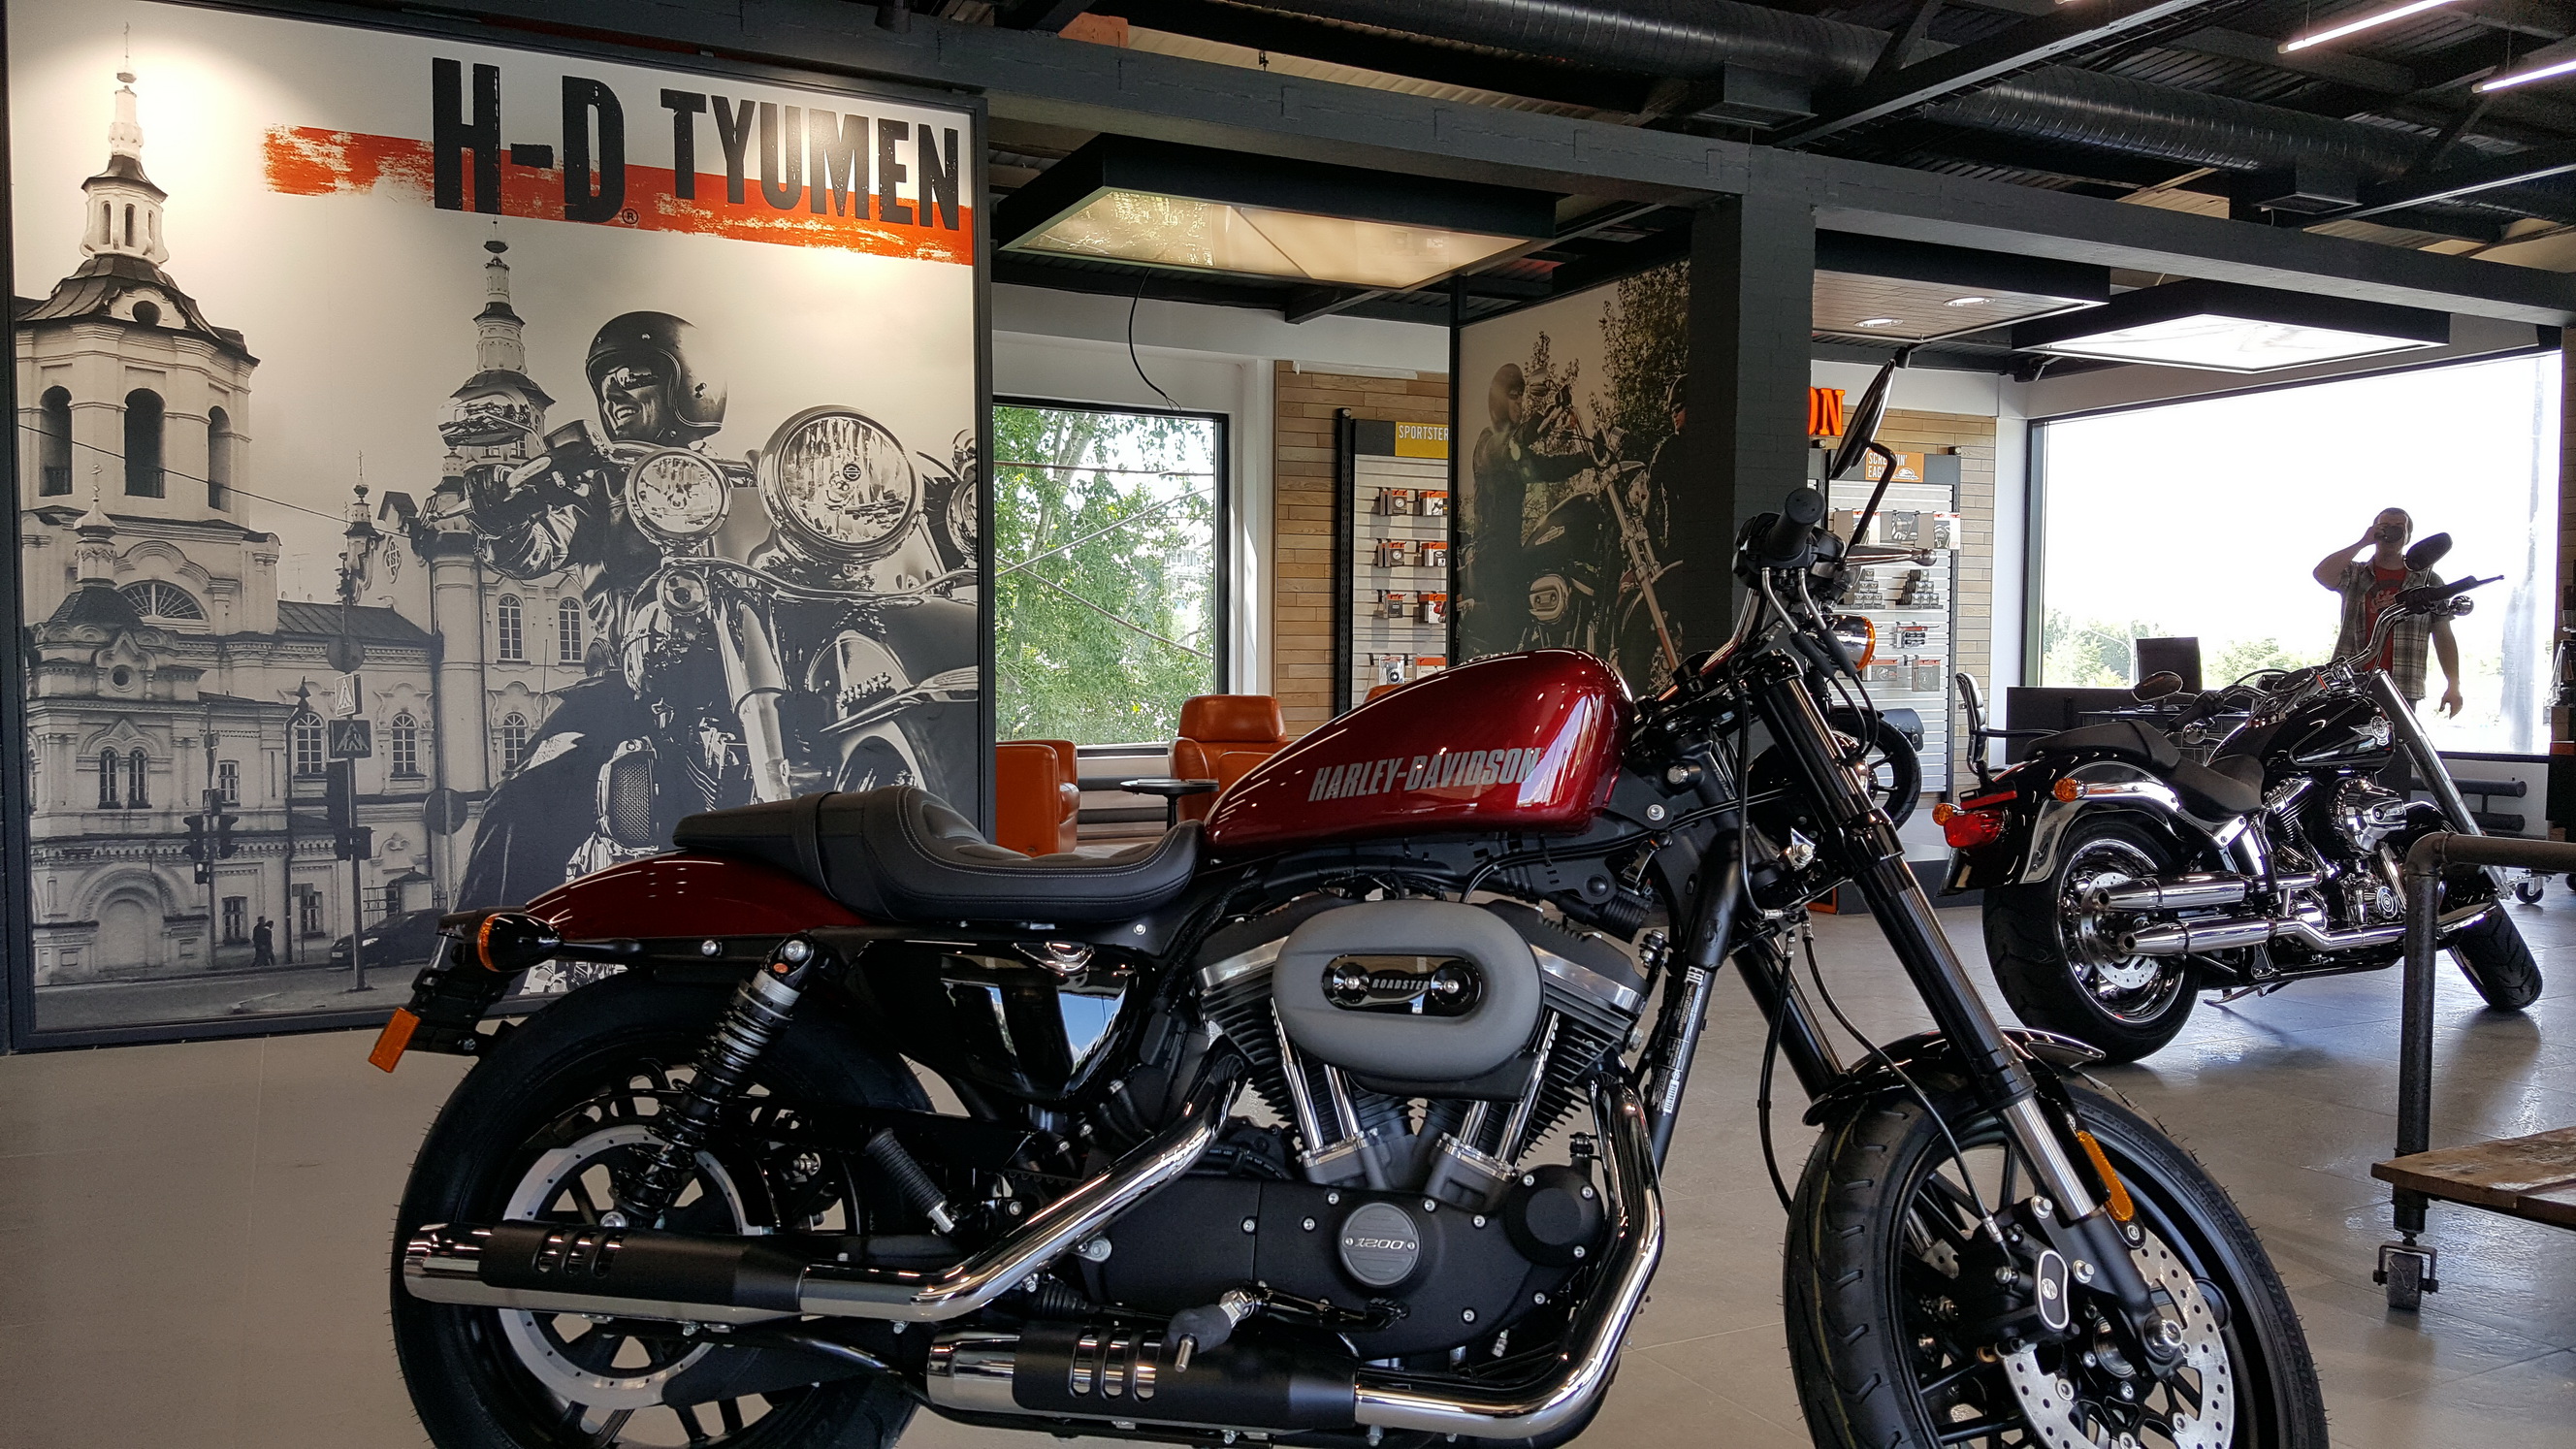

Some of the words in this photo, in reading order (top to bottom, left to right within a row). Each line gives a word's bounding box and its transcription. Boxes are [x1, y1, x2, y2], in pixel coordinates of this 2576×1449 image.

[660, 88, 960, 231] TYUMEN
[1399, 425, 1449, 441] SPORTSTER
[1868, 452, 1908, 467] SCREIN'
[1307, 747, 1541, 802] HARLEY-DAVIDSON
[1371, 979, 1431, 990] ROADSTER
[1355, 1238, 1405, 1250] 1200
